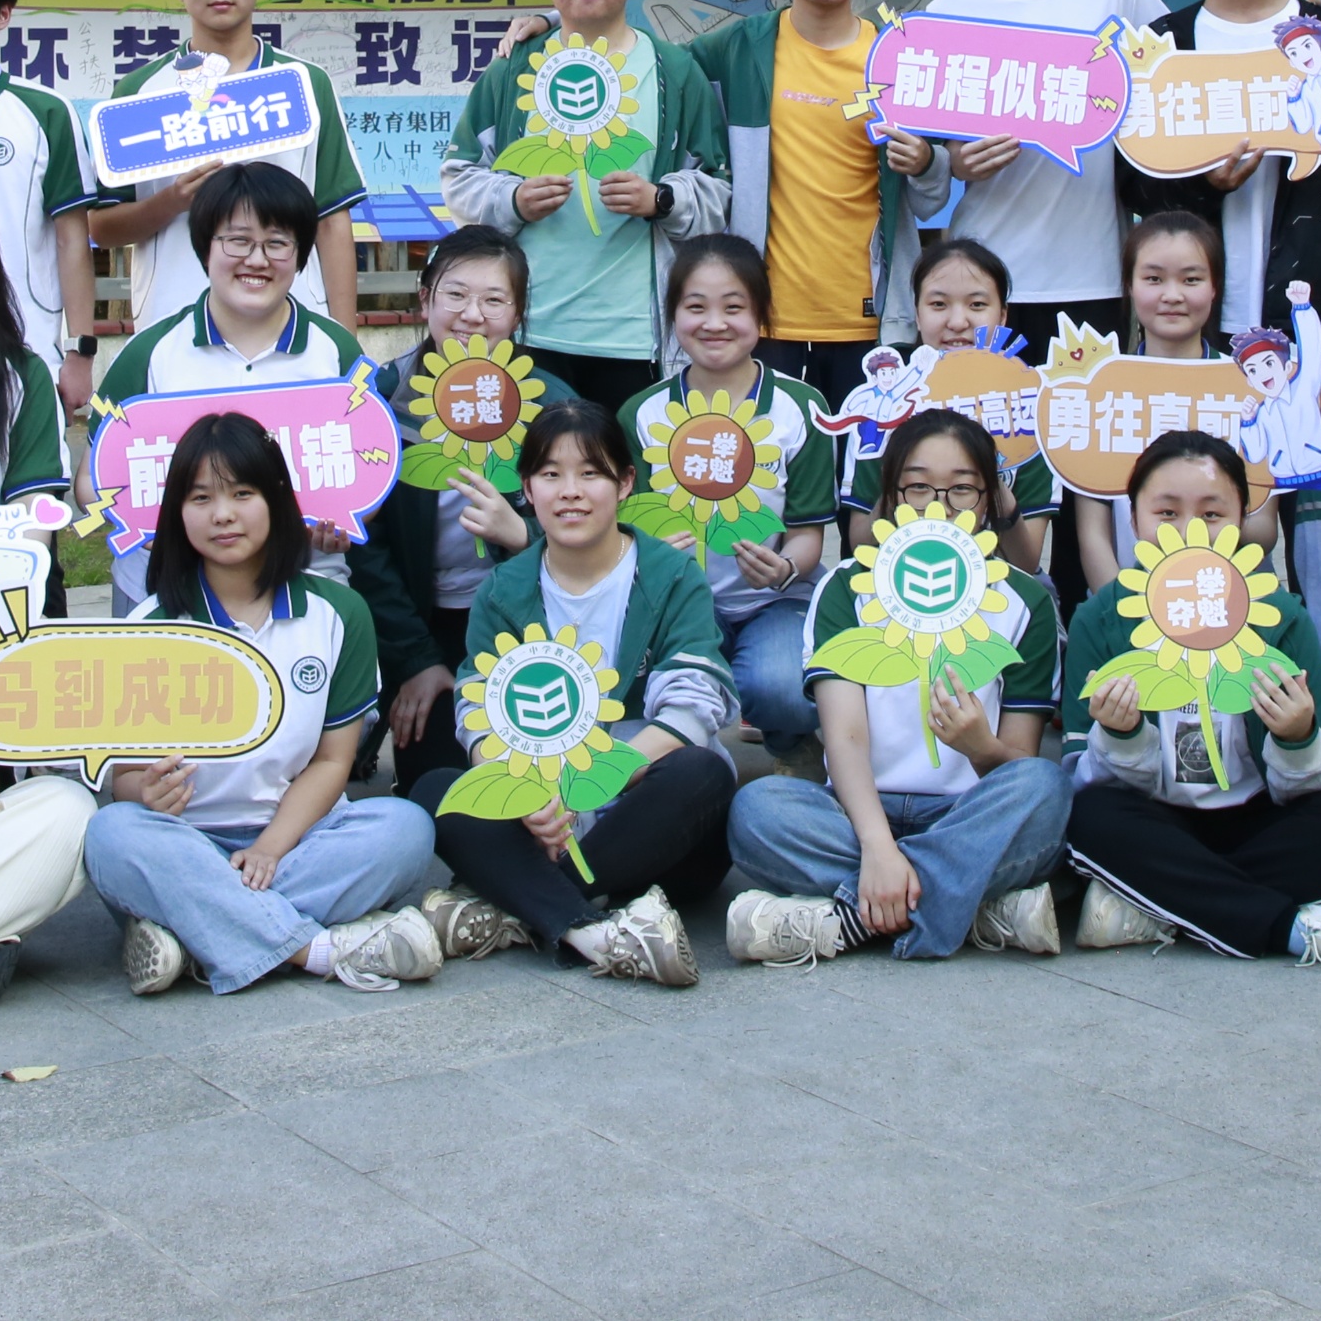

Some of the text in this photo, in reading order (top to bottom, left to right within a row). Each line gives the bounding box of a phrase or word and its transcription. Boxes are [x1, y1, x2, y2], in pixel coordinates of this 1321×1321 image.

[892, 46, 1090, 125] 前程似锦
[119, 91, 292, 152] 一路前行
[1119, 75, 1289, 140] 勇往直前
[449, 373, 502, 400] 一举
[449, 399, 503, 426] 夺魁
[685, 432, 739, 459] 一举
[683, 458, 736, 485] 夺魁
[1165, 566, 1228, 597] 一举
[1166, 596, 1229, 630] 夺魁
